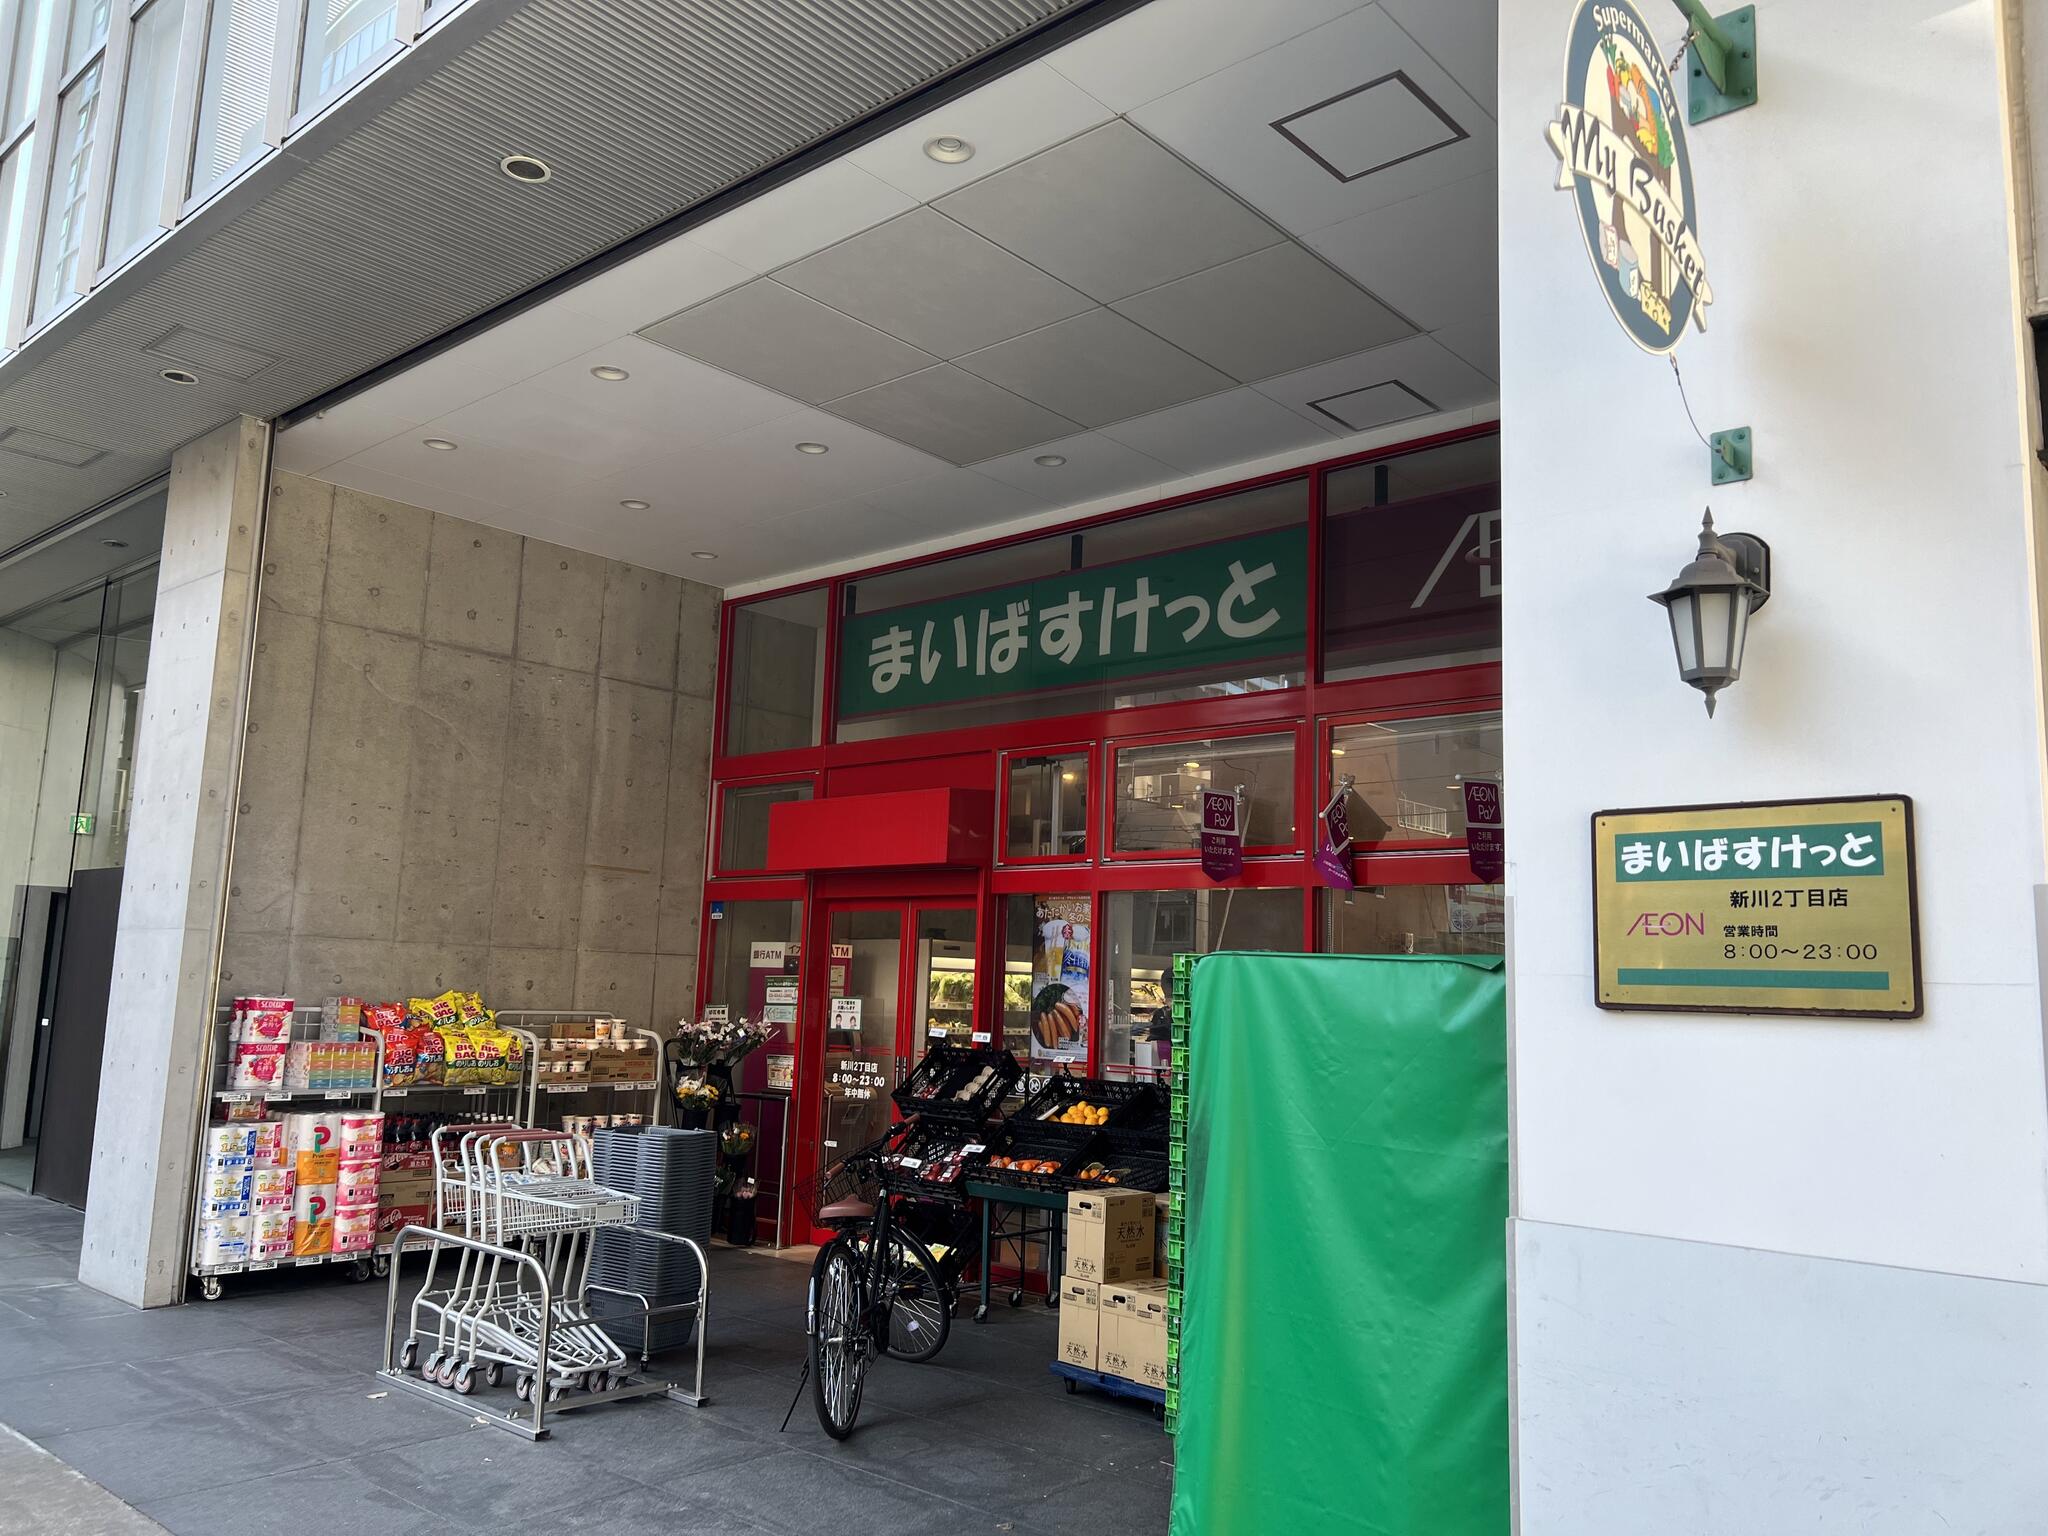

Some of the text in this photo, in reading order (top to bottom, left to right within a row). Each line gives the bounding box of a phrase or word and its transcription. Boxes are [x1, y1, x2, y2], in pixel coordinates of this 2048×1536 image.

[1593, 4, 1676, 121] Supermarket
[1561, 108, 1704, 299] My Basket
[867, 559, 1281, 695] まいばすけっと
[1620, 832, 1877, 875] まいばすけっと
[1729, 888, 1849, 909] 新川2丁目店
[1723, 925, 1779, 939] 営業時間
[433, 1008, 455, 1019] BAG
[480, 1044, 499, 1052] BIG
[840, 1060, 878, 1074] 新川2丁目店
[1116, 1224, 1145, 1240] 天然水
[1073, 1259, 1097, 1273] 天然水
[1065, 1344, 1088, 1358] 天然水
[1105, 1354, 1128, 1369] 天然水
[1143, 1365, 1167, 1379] 天然水
